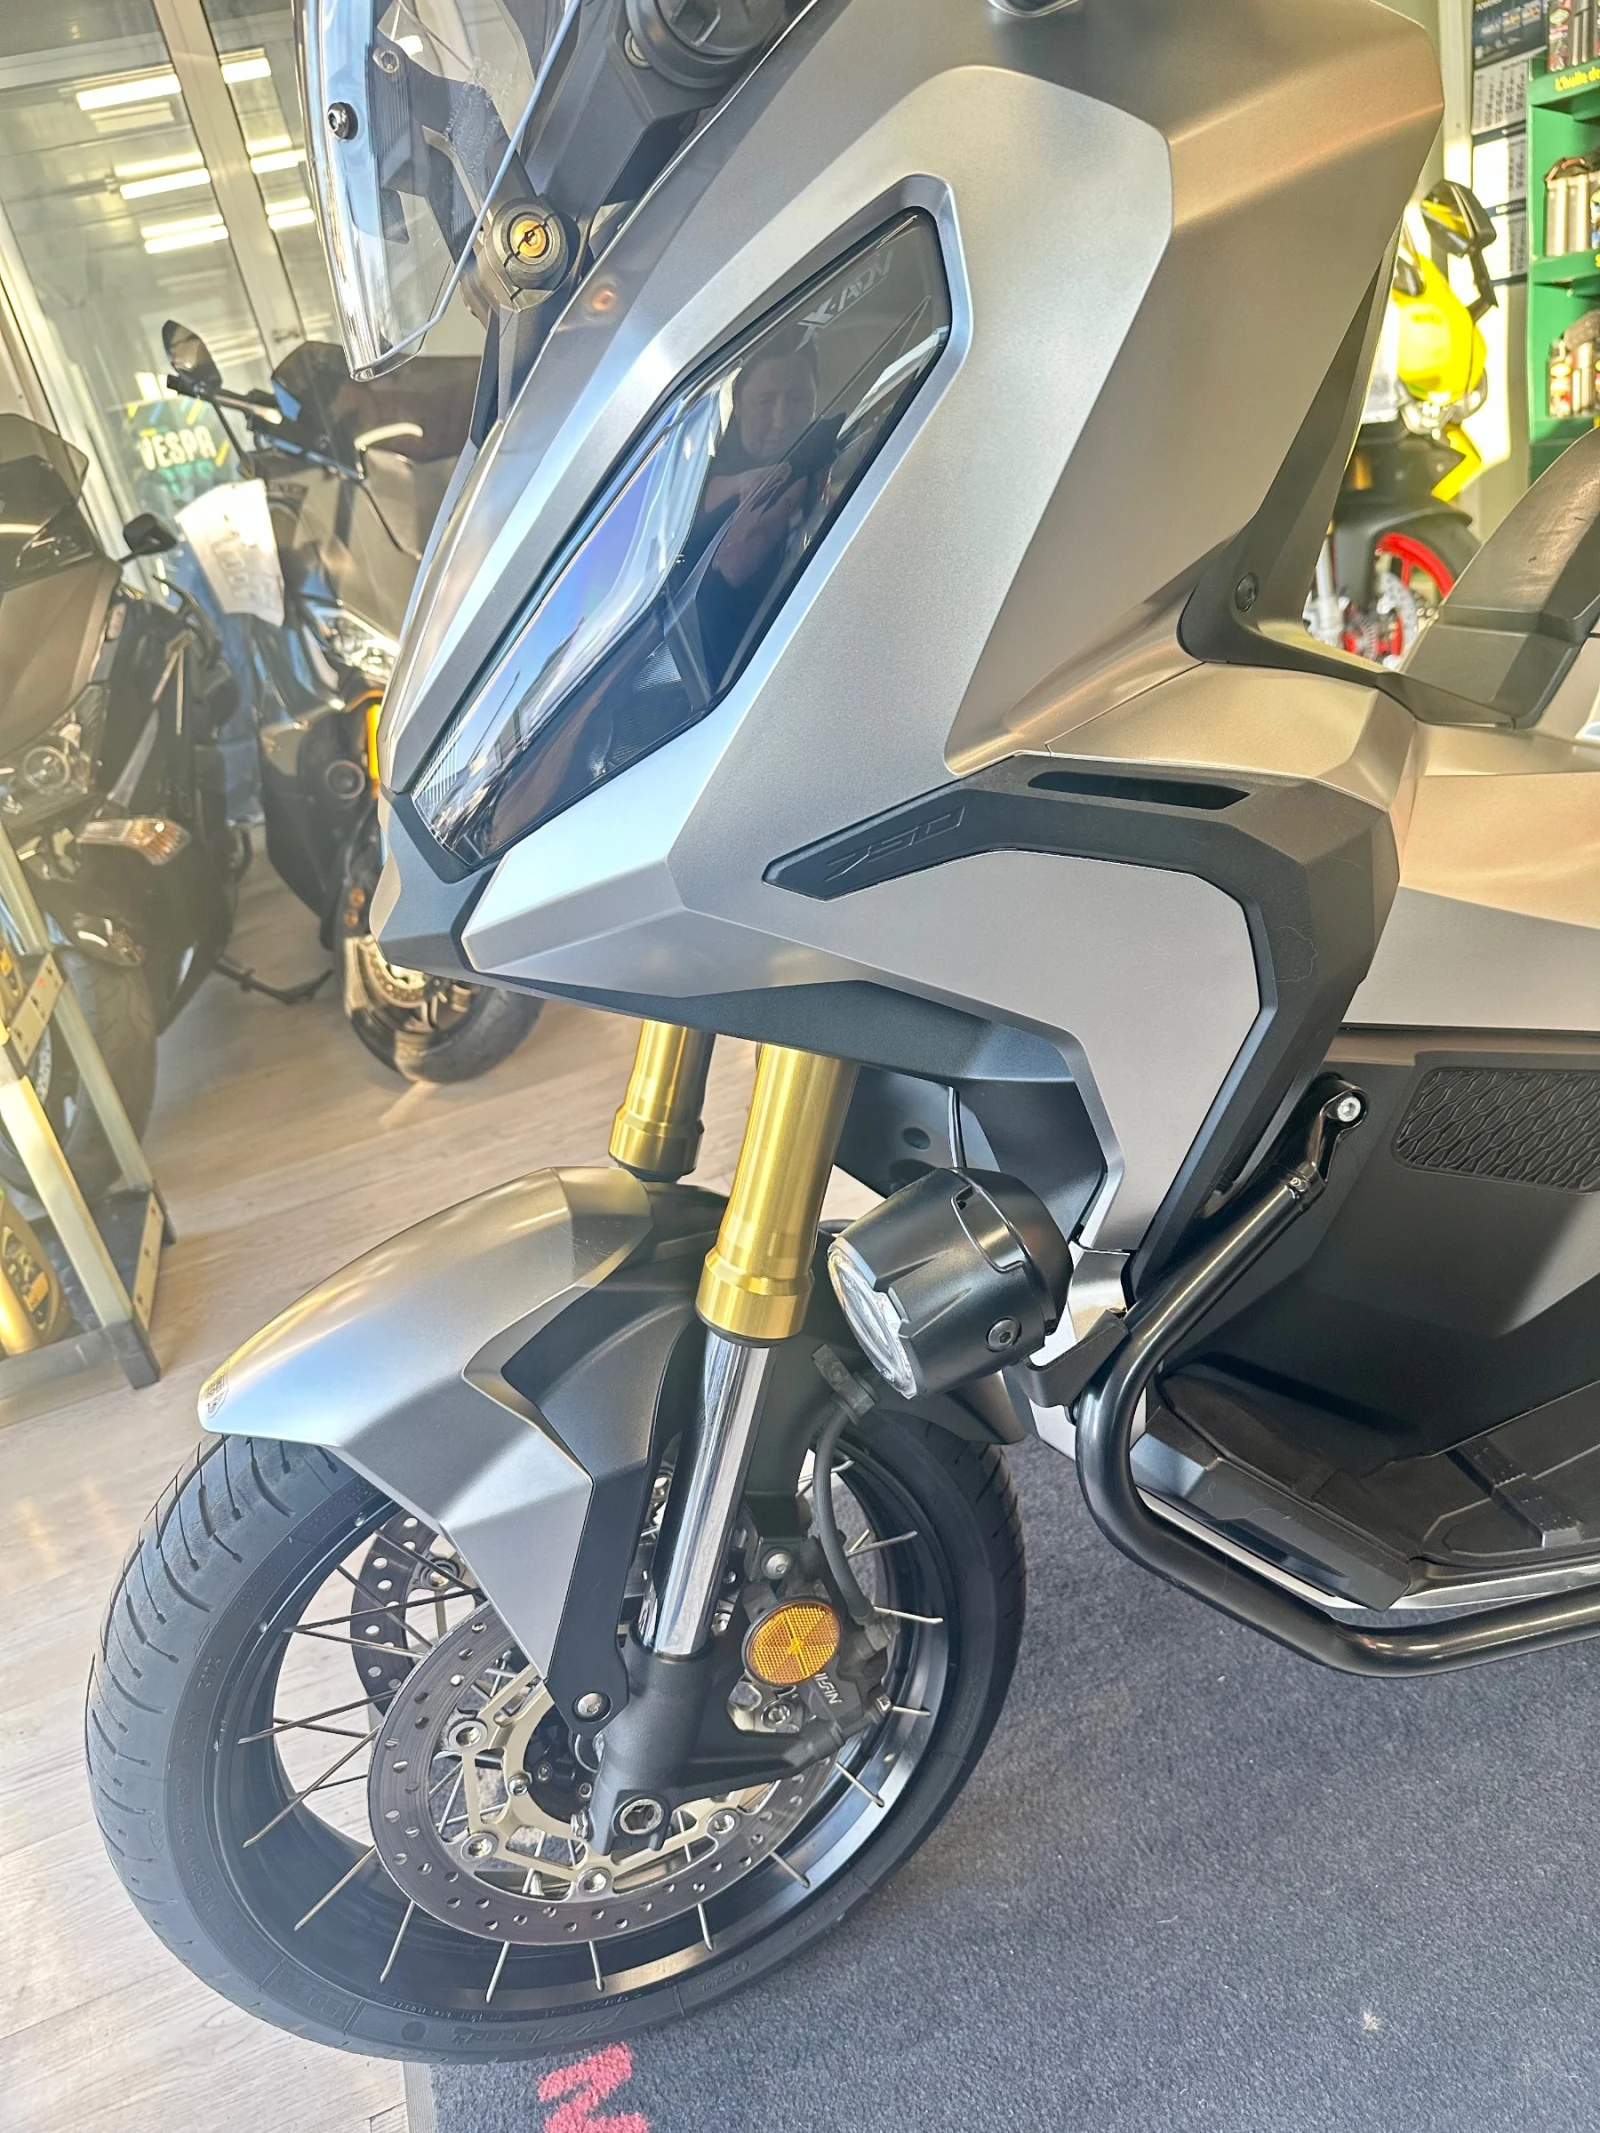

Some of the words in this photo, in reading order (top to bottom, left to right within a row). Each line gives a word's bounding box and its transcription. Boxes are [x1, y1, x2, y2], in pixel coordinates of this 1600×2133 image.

[794, 247, 894, 353] X-ADV
[138, 424, 218, 471] VESPA
[823, 806, 966, 884] 750
